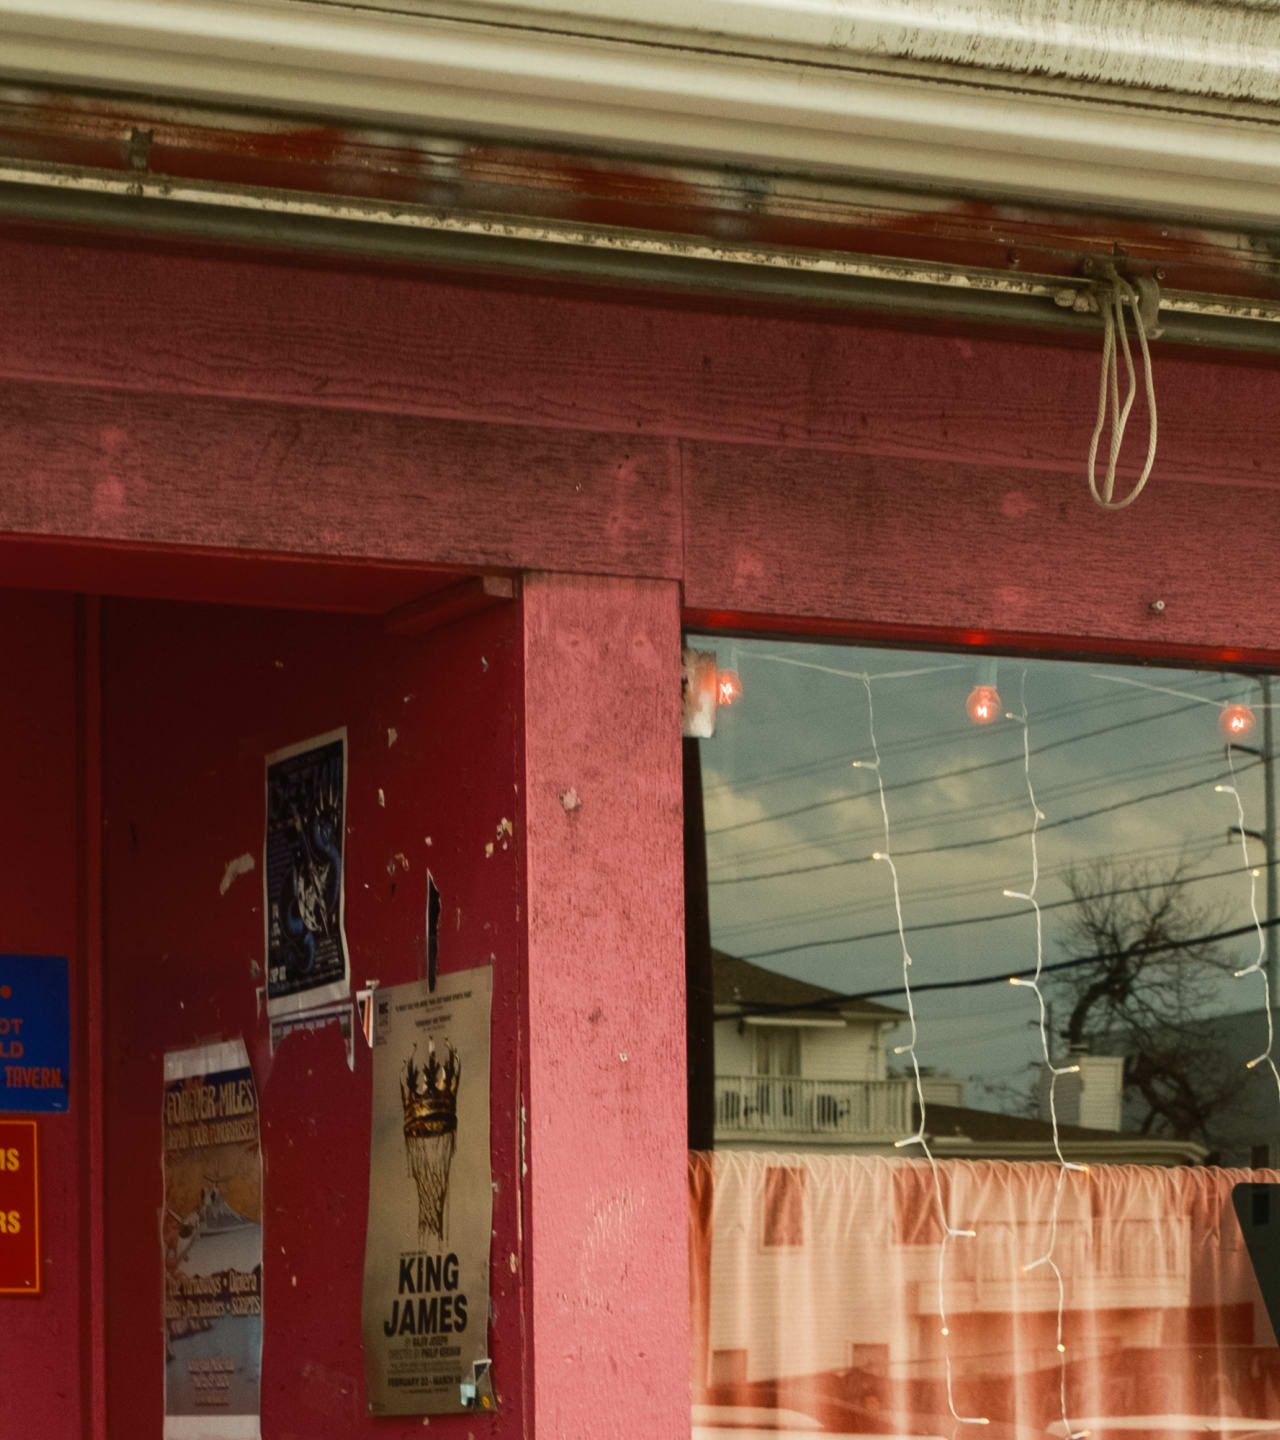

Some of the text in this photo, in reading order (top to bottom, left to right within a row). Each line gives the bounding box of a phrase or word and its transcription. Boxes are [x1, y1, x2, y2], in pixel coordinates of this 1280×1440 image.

[217, 1079, 255, 1117] MILES
[398, 1253, 459, 1295] KING
[383, 1294, 468, 1337] JAMES
